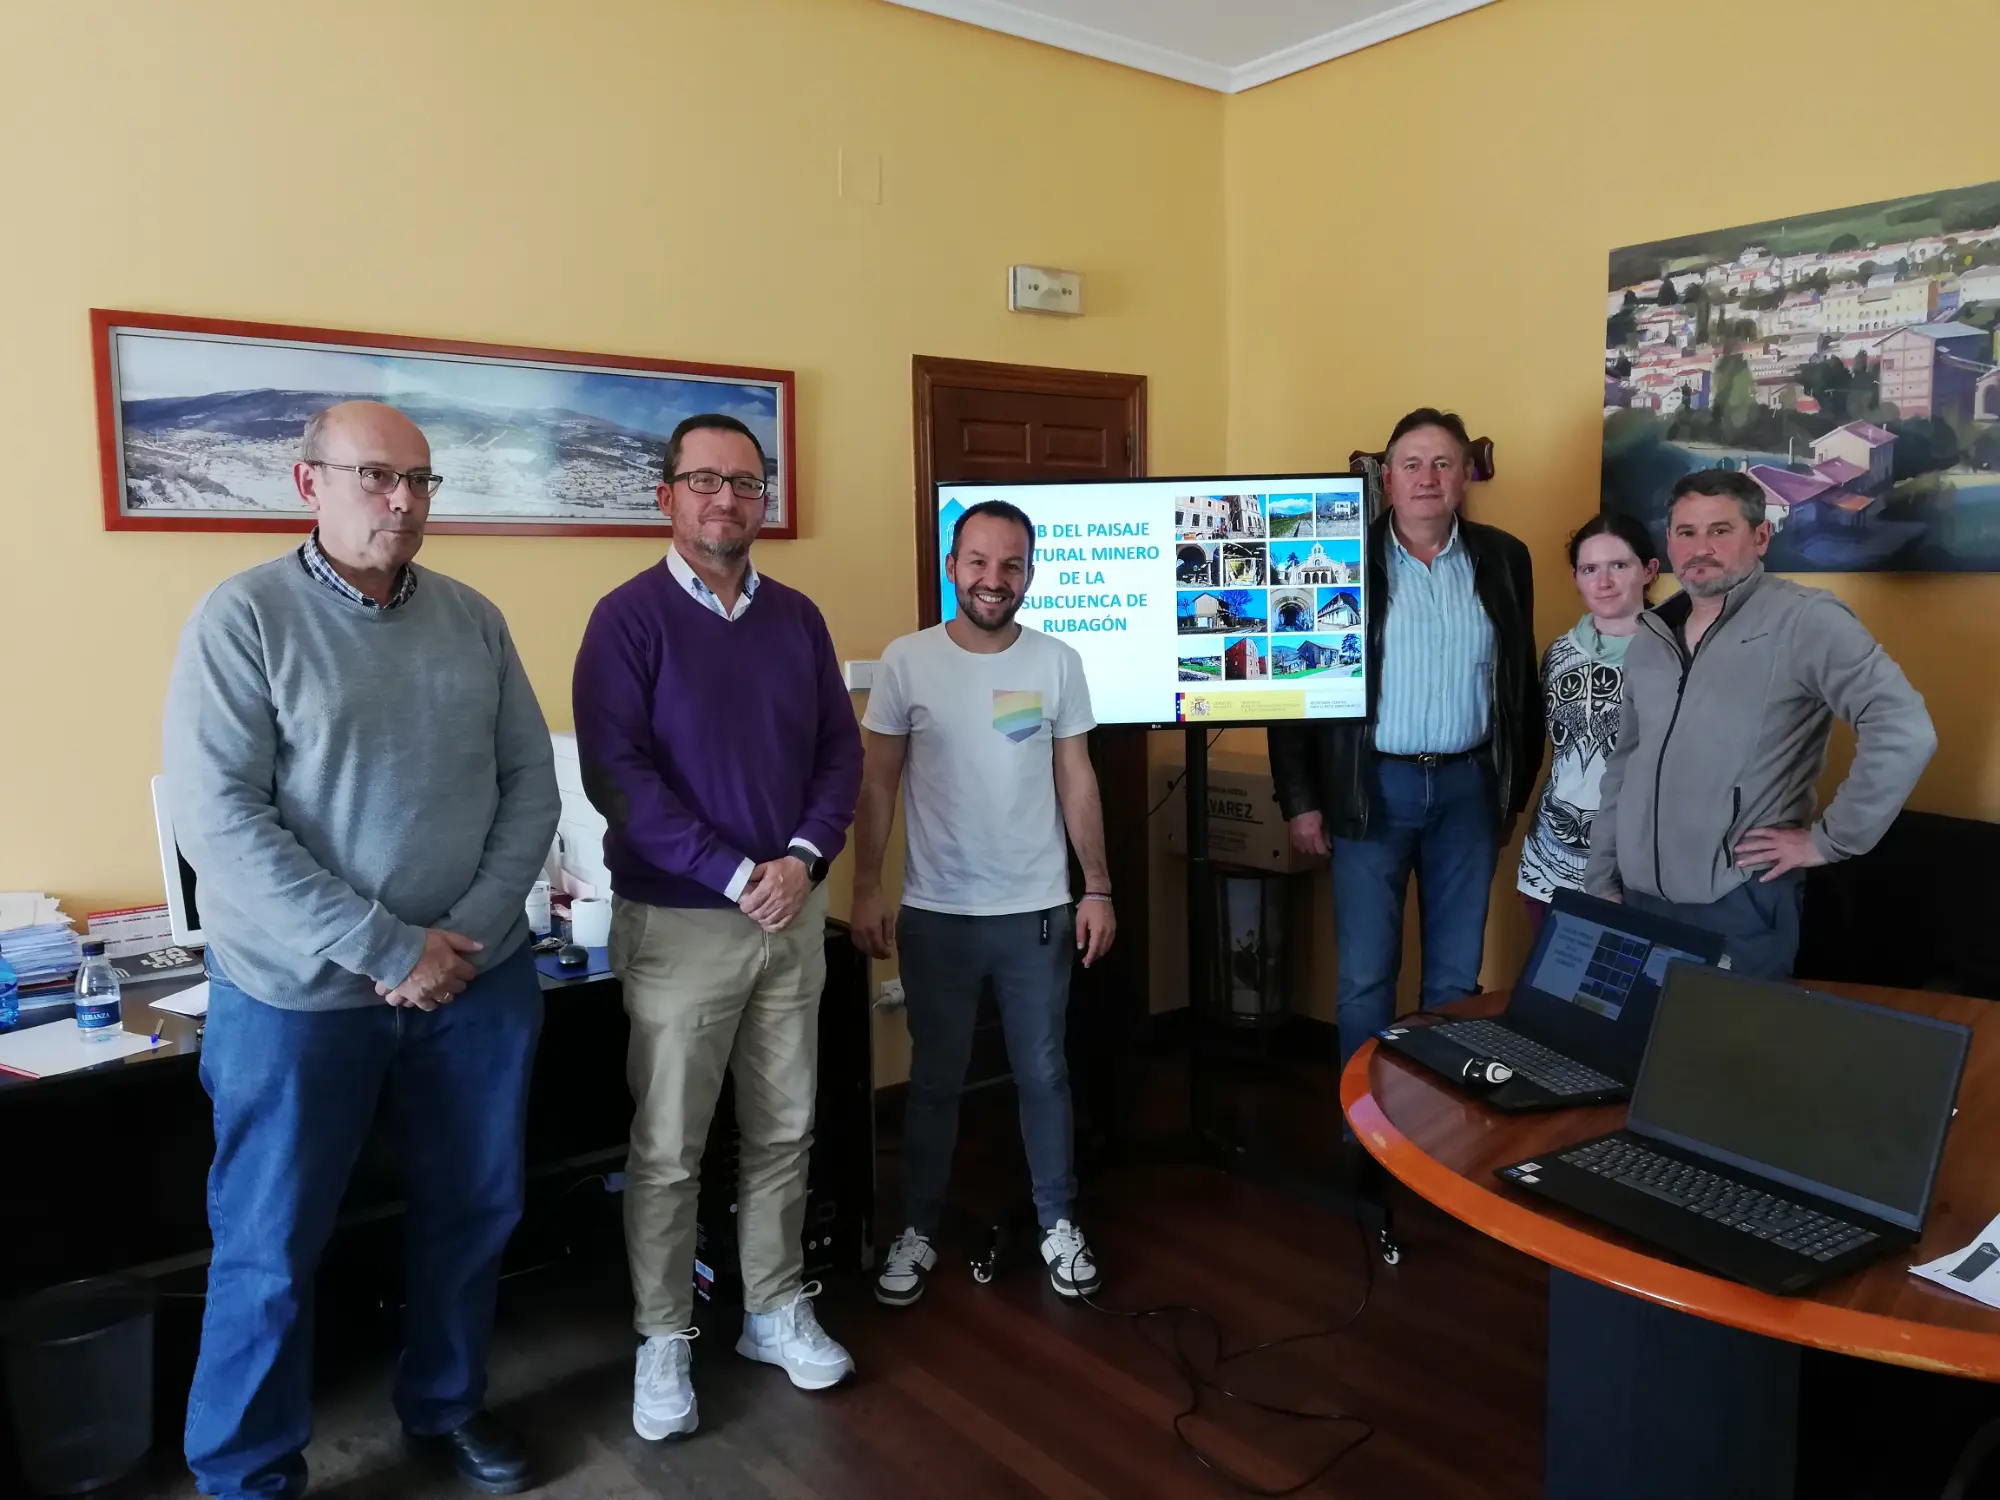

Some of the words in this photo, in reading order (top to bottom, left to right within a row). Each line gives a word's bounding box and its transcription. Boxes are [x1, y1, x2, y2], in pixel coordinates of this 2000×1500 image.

[1033, 524, 1047, 538] B
[1053, 524, 1083, 538] DEL
[1087, 522, 1150, 537] PAISAJE
[1033, 547, 1087, 562] TURAL
[1091, 545, 1160, 561] MINERO
[1059, 571, 1080, 585] DE
[1085, 571, 1105, 585] LA
[1022, 594, 1121, 609] SUBCUENCA
[1126, 593, 1147, 607] DE
[1043, 614, 1127, 632] RUBAGÓN
[1208, 798, 1253, 819] VAREZ
